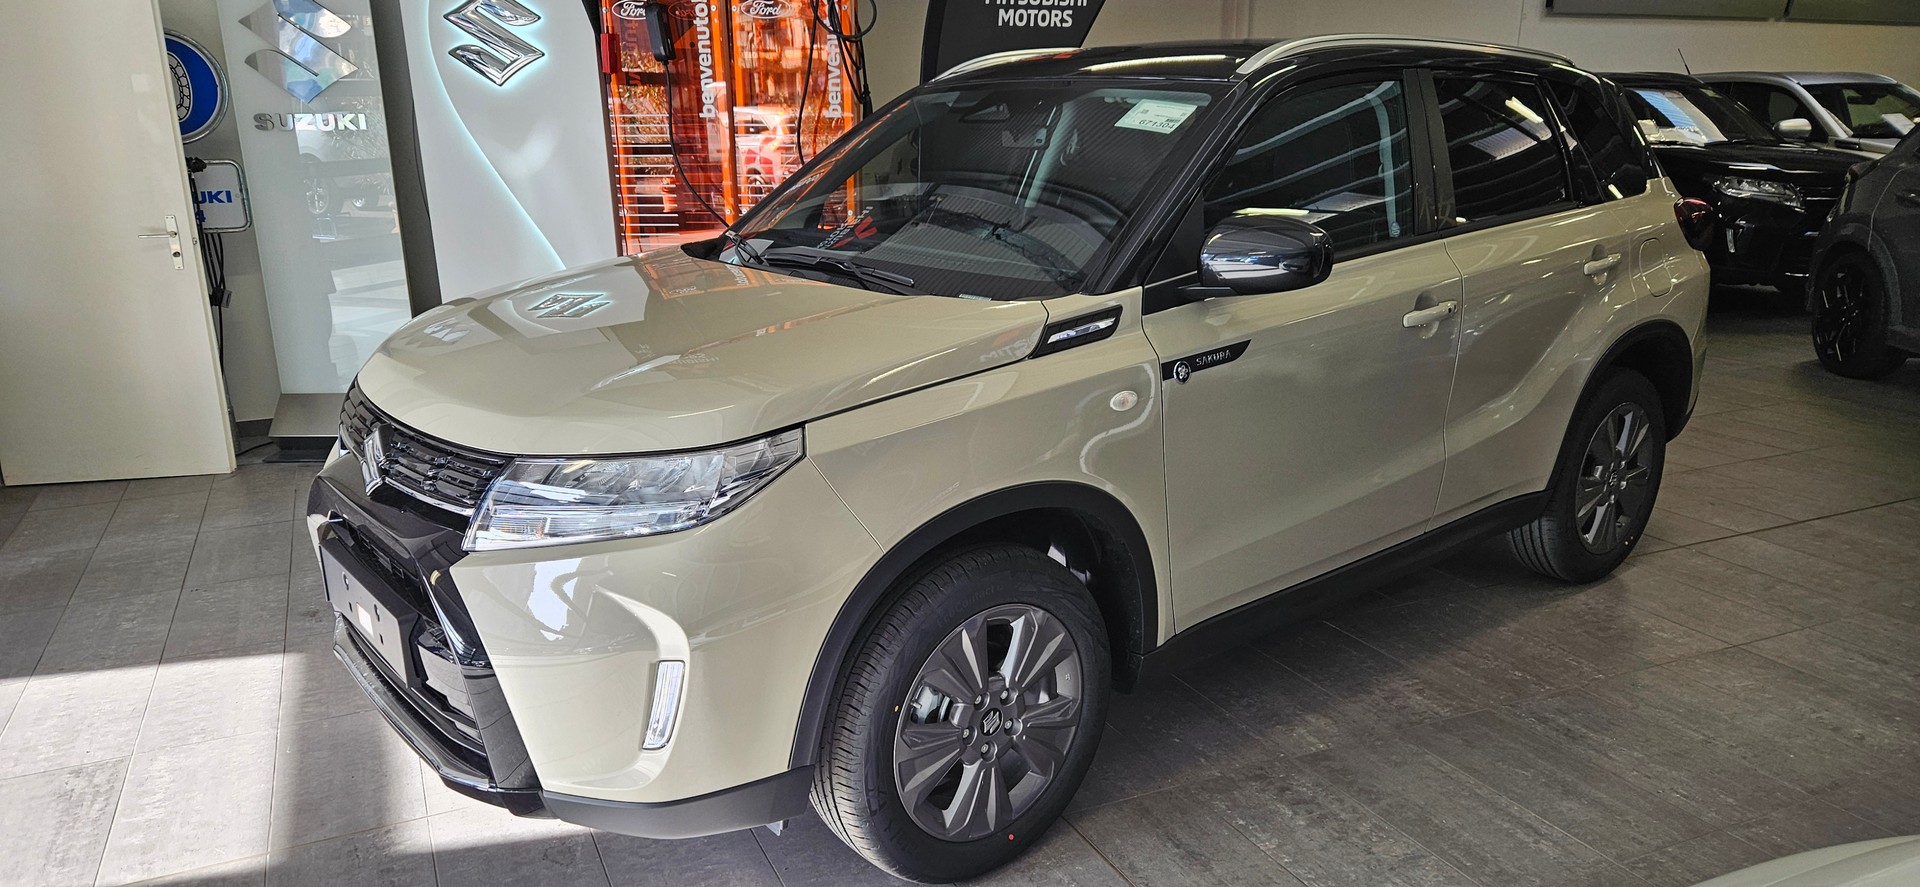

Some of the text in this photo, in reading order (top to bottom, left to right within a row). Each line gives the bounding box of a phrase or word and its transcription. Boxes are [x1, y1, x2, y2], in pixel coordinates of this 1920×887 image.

[620, 1, 646, 17] For
[750, 1, 782, 15] Ford
[998, 8, 1073, 27] MOTORS
[253, 113, 367, 132] SUZUKI
[198, 190, 232, 204] UKI
[1196, 350, 1231, 366] SAKURA
